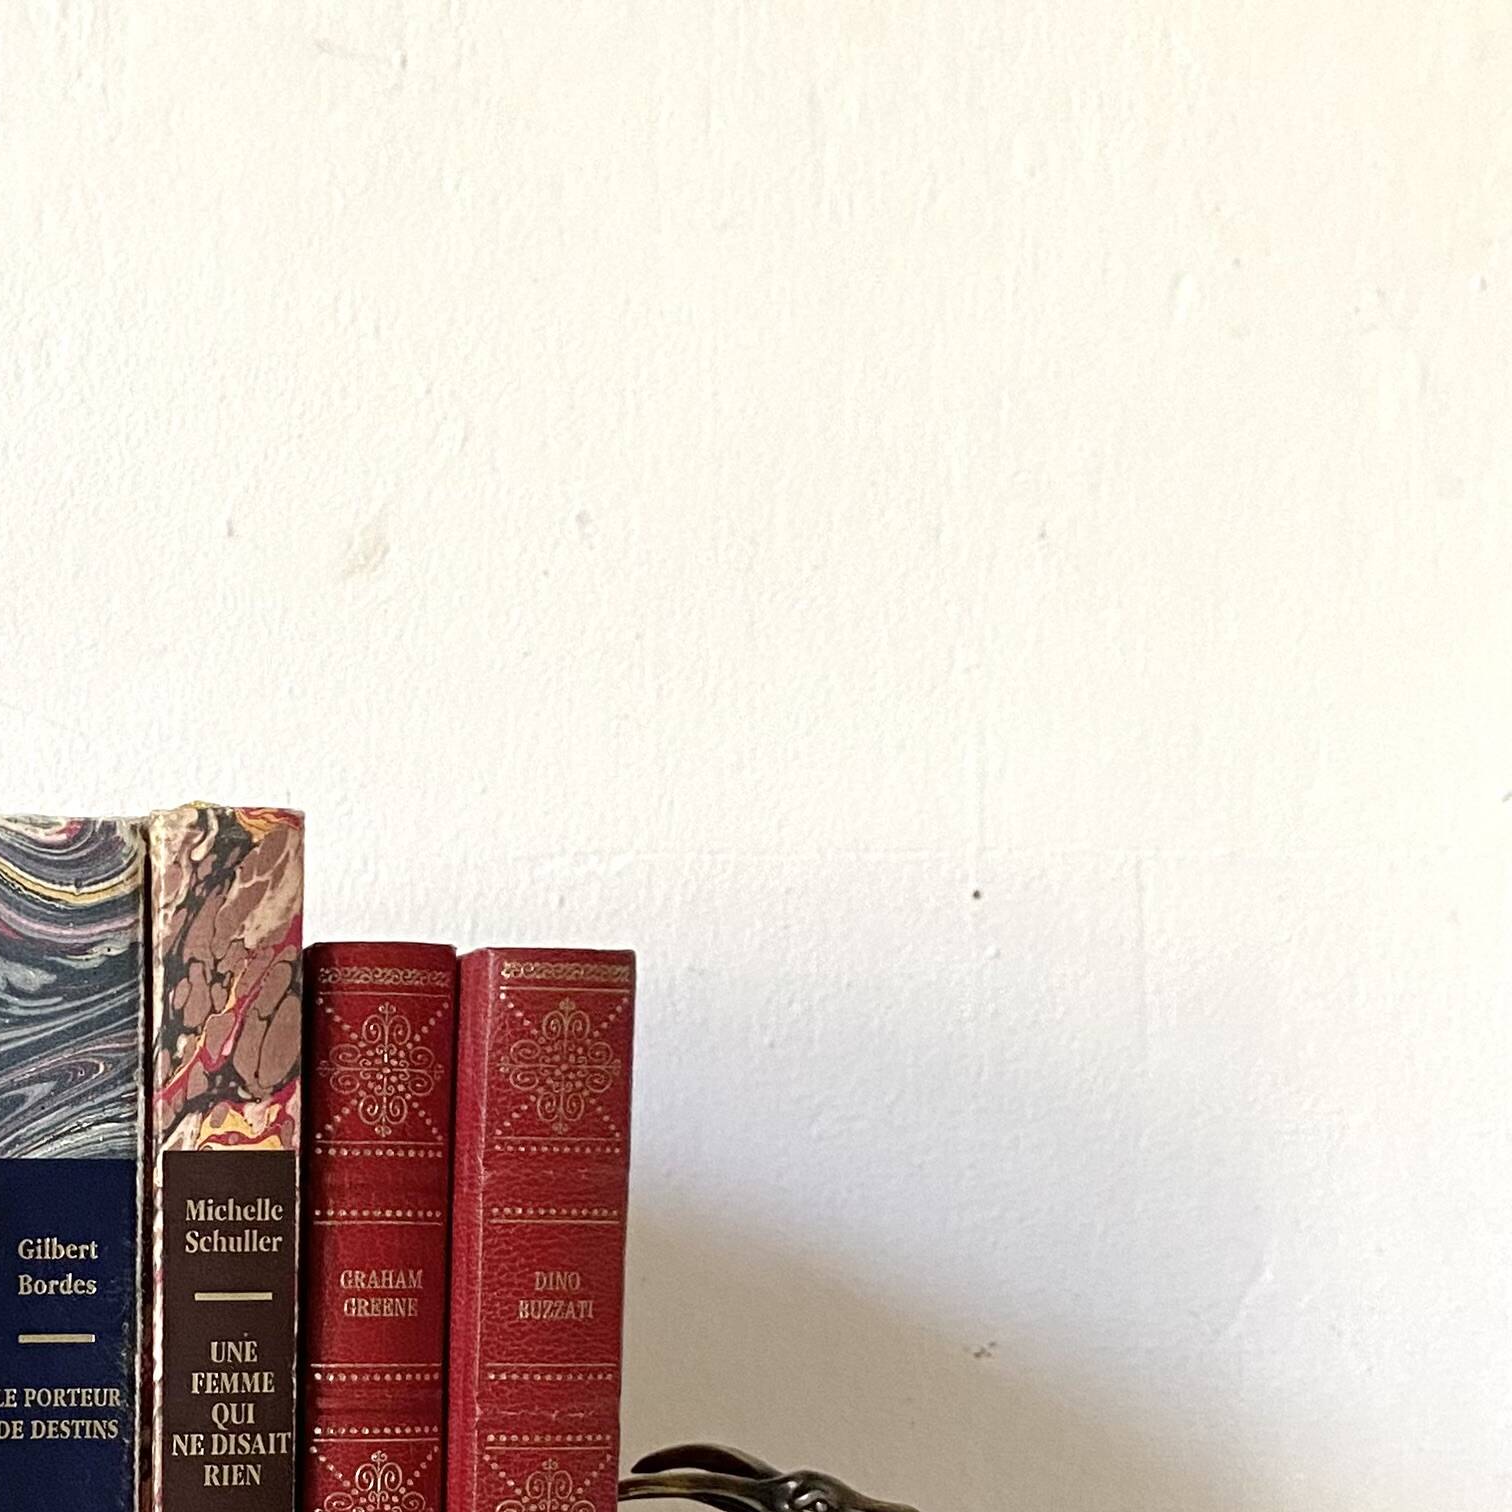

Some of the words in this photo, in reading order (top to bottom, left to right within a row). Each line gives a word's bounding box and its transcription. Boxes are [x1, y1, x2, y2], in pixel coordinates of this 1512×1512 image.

[185, 1199, 284, 1222] Michelle
[17, 1237, 99, 1260] Gilbert
[185, 1230, 283, 1253] Schuller
[17, 1273, 97, 1296] Bordes
[340, 1269, 423, 1289] GRAHAM
[534, 1271, 582, 1292] DINO
[343, 1297, 419, 1317] GREENE
[518, 1299, 594, 1320] BUZZATI
[210, 1340, 258, 1363] UNE
[191, 1372, 275, 1394] FEMME
[24, 1387, 122, 1408] PORTEUR
[211, 1402, 255, 1430] QUI
[30, 1419, 120, 1440] DESTINS
[172, 1434, 205, 1456] NE
[211, 1432, 292, 1456] DISAIT
[203, 1464, 262, 1487] RIEN
